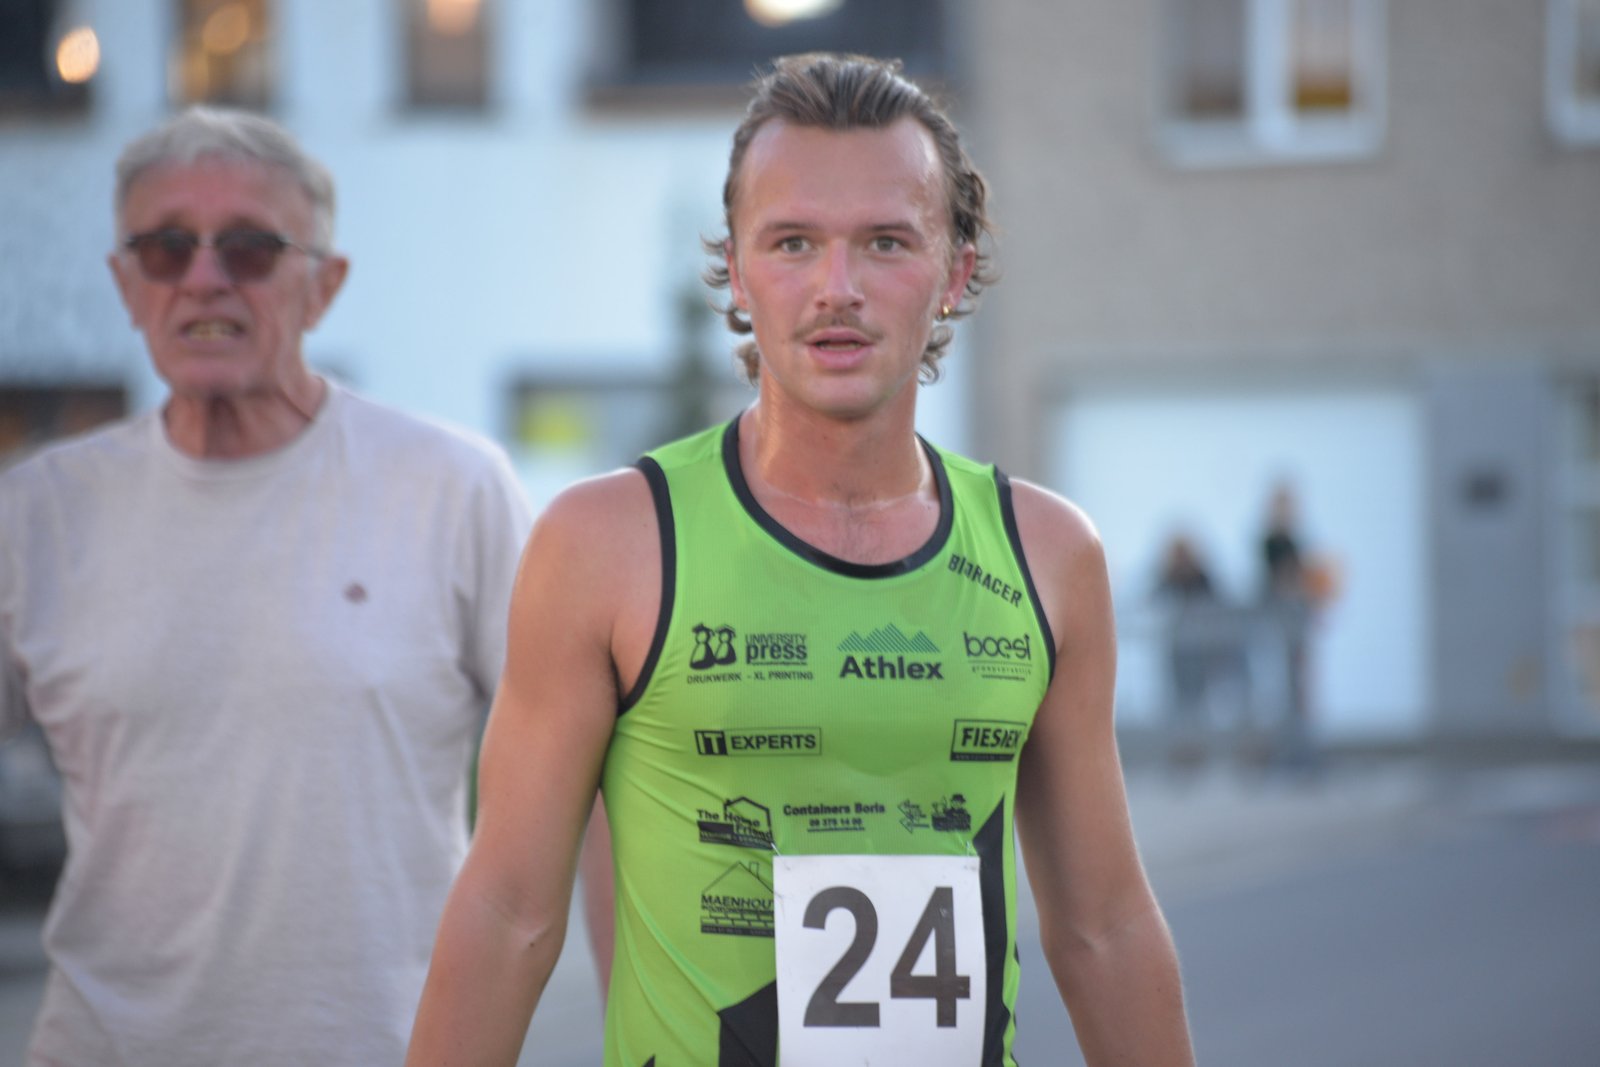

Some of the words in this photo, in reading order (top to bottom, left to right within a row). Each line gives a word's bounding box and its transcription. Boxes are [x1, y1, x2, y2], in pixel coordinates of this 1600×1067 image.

[746, 643, 808, 665] press
[768, 670, 814, 680] PRINTING
[839, 655, 944, 680] Athlex
[730, 734, 817, 750] EXPERTS
[696, 809, 719, 820] The
[783, 804, 851, 816] Containers
[854, 802, 885, 813] Boris
[701, 893, 774, 909] MAENHOU
[802, 886, 971, 1028] 24
